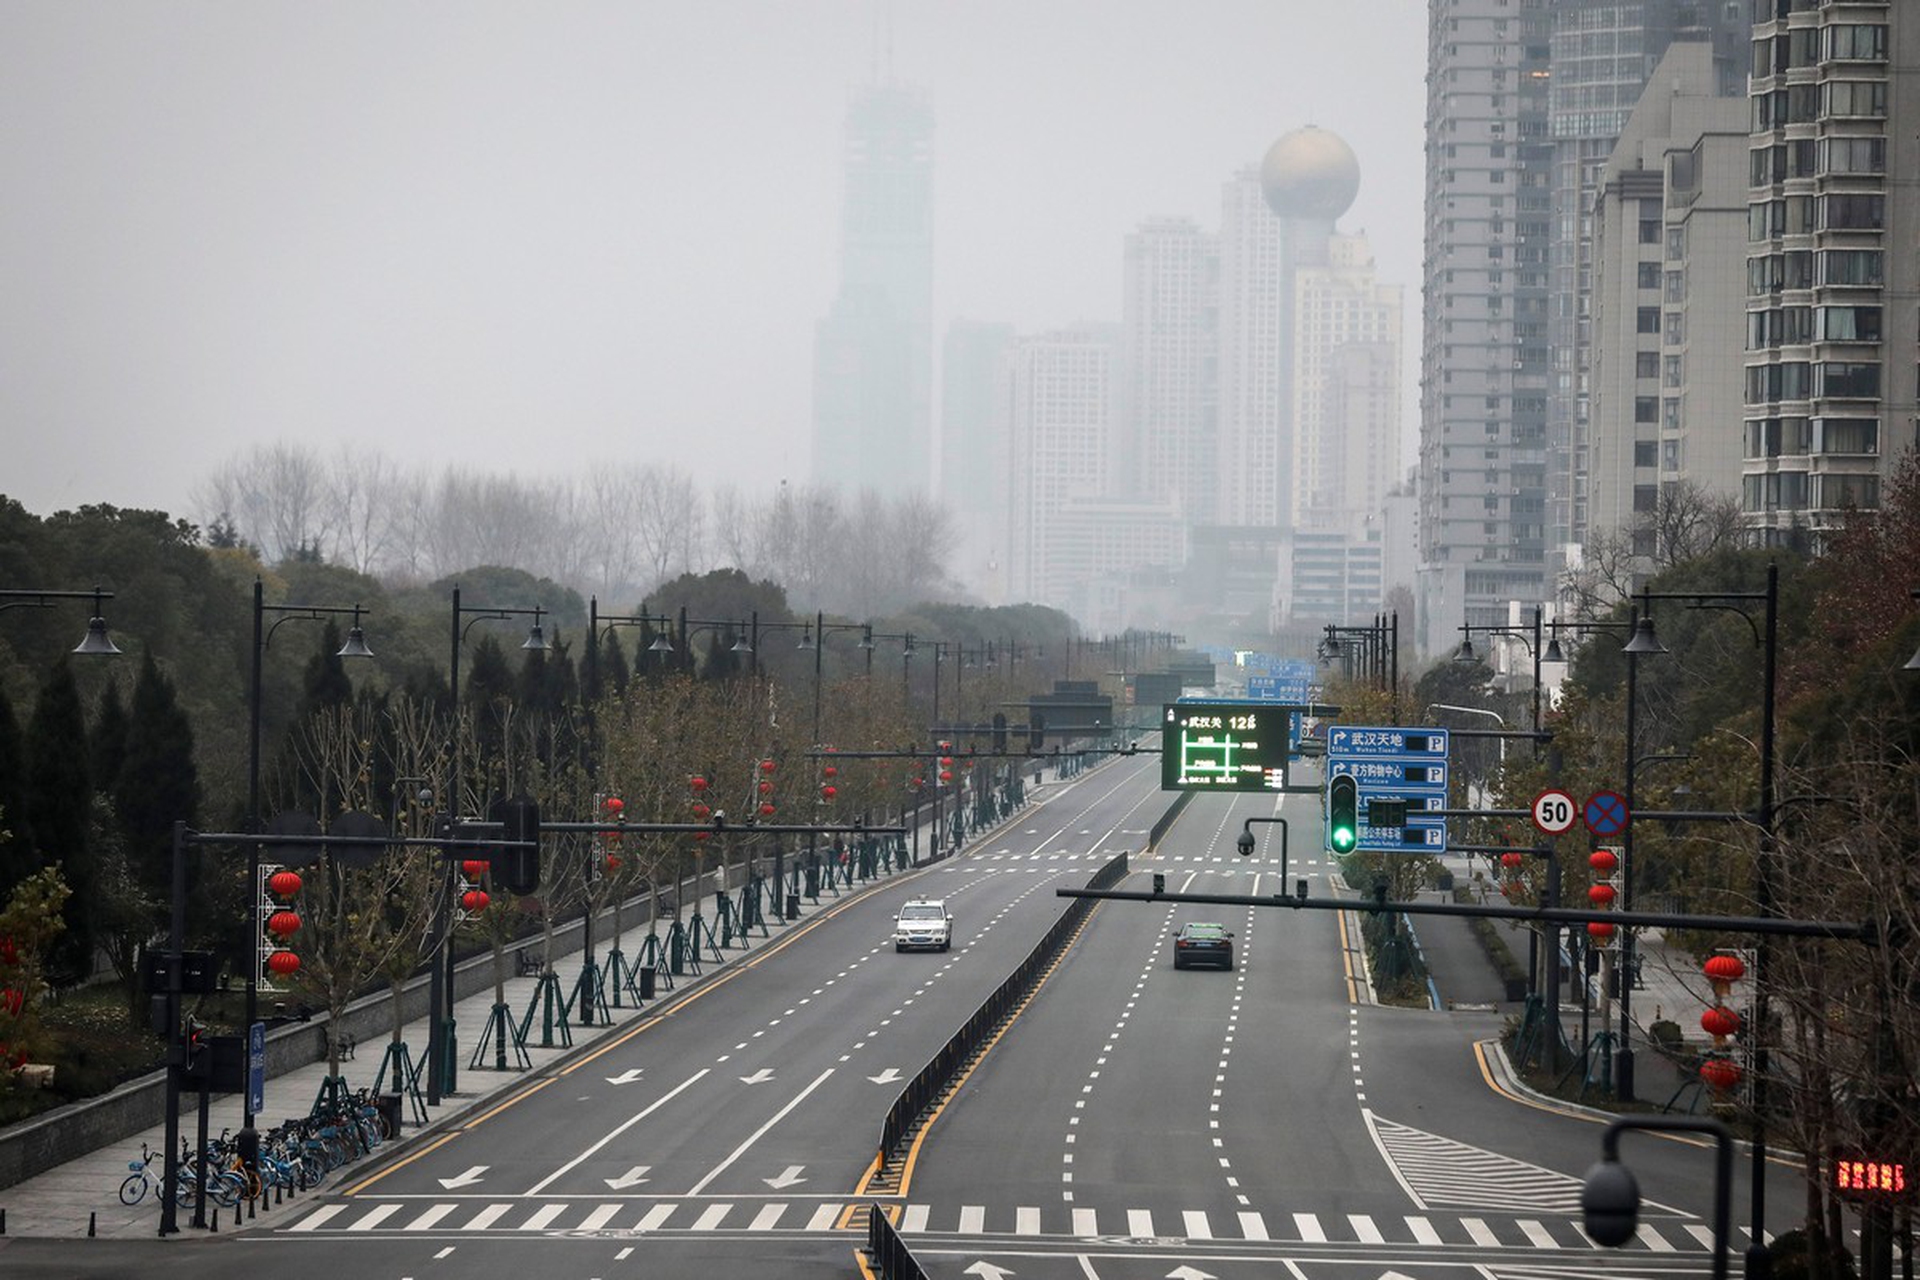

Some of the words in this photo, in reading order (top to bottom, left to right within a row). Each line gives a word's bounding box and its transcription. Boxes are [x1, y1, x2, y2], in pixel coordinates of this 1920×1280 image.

[1189, 716, 1222, 729] 武汉关
[1351, 732, 1403, 747] 武汉天地
[1431, 737, 1441, 750] P
[1431, 768, 1440, 781] P
[1542, 802, 1567, 823] 50
[1430, 831, 1439, 844] P
